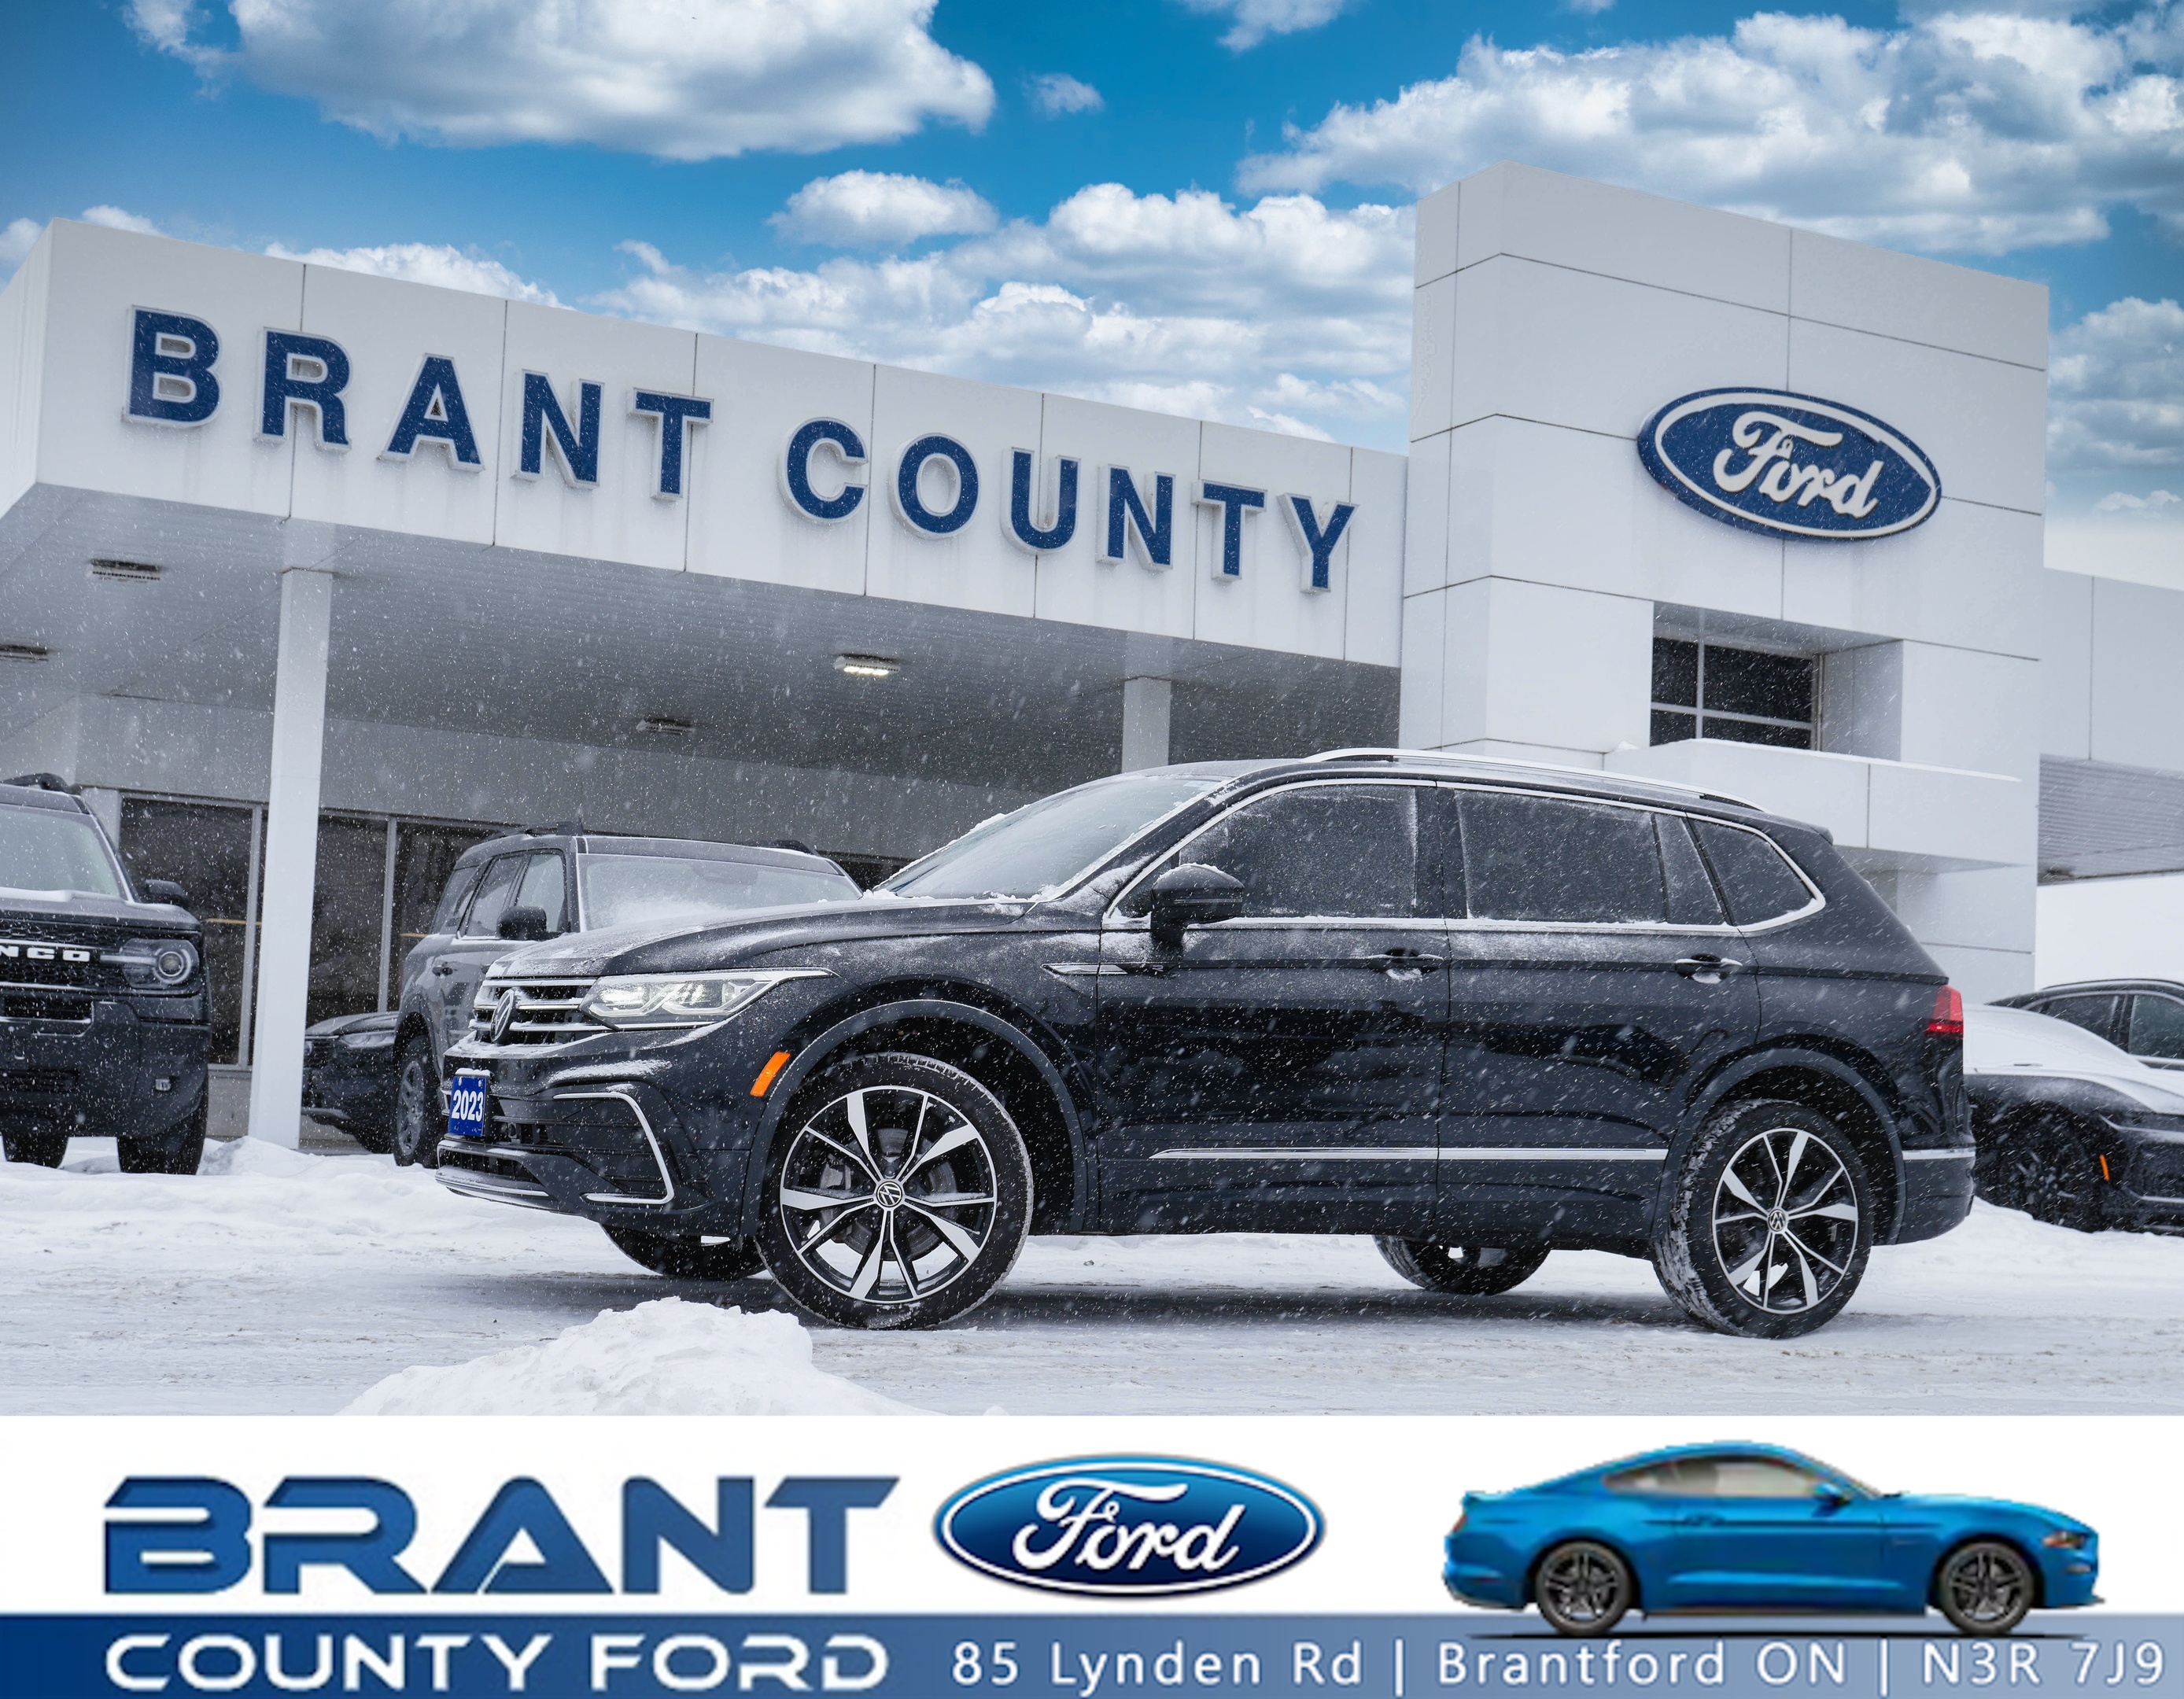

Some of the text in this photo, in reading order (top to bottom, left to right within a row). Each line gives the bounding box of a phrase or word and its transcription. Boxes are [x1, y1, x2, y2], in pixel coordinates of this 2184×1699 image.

[123, 305, 1359, 595] BRANT COUNTY
[1713, 411, 1885, 519] Ford
[451, 1089, 484, 1122] 2023
